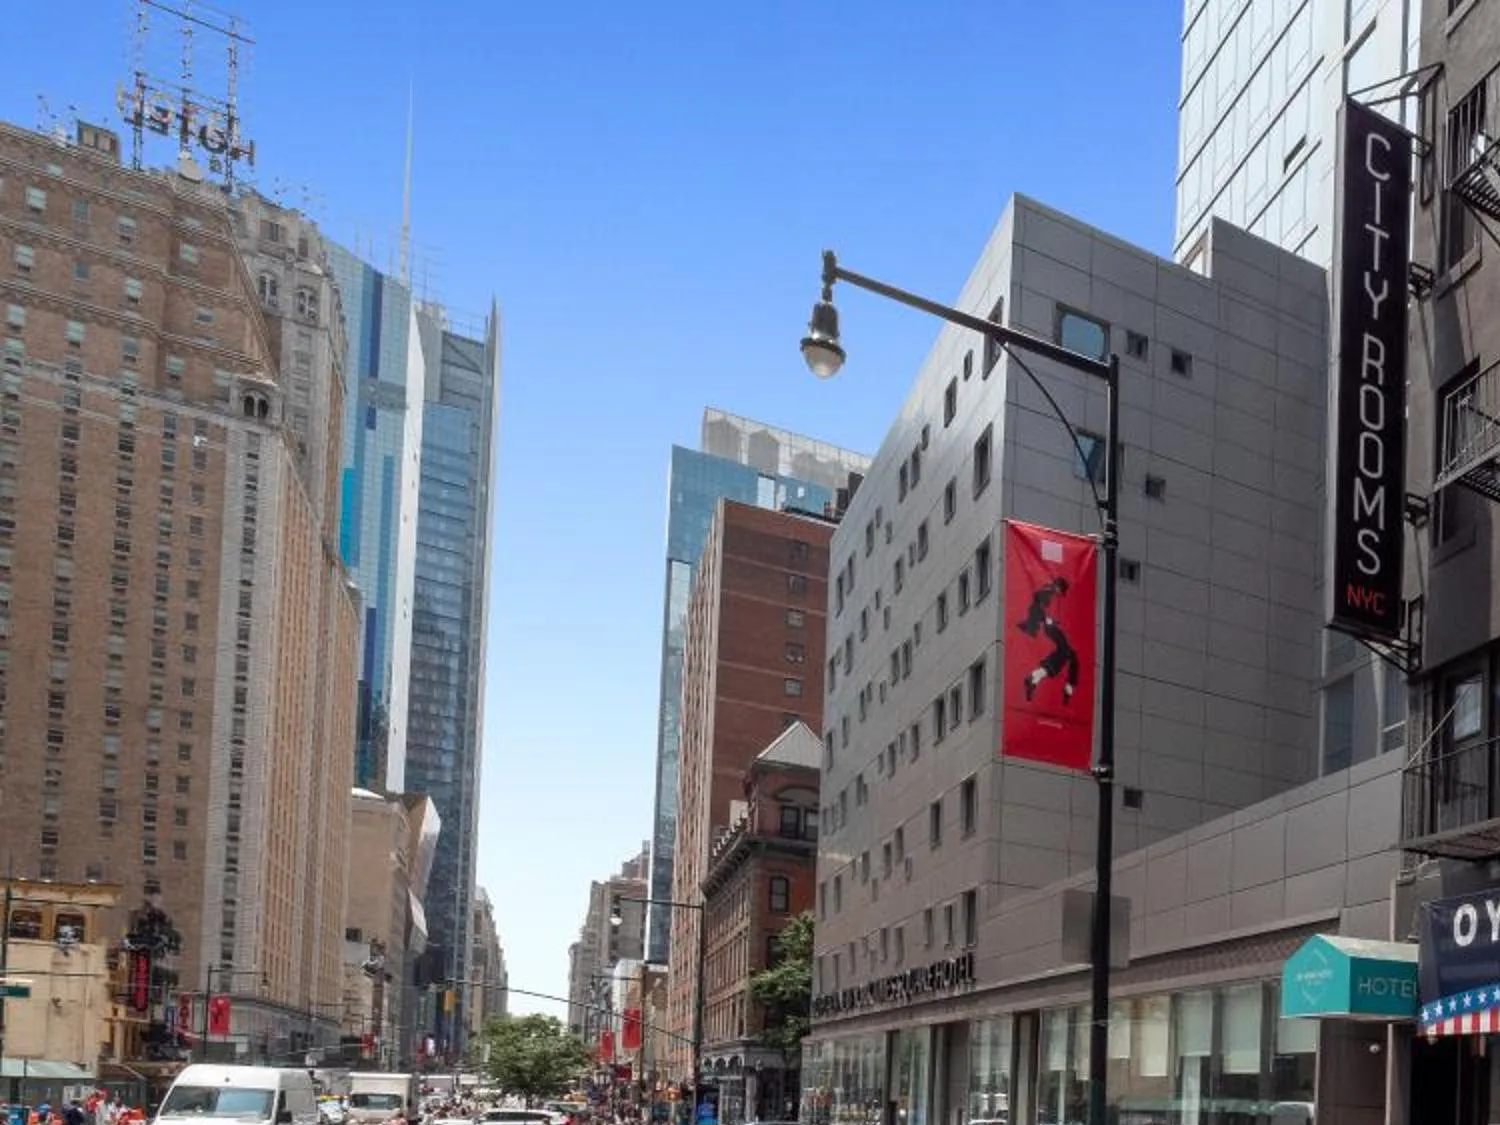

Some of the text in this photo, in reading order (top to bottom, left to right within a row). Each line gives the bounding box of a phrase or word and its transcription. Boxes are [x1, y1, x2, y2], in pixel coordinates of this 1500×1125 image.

[1354, 132, 1391, 575] CITY ROOMS
[1346, 583, 1386, 616] NYC
[1453, 903, 1479, 948] O
